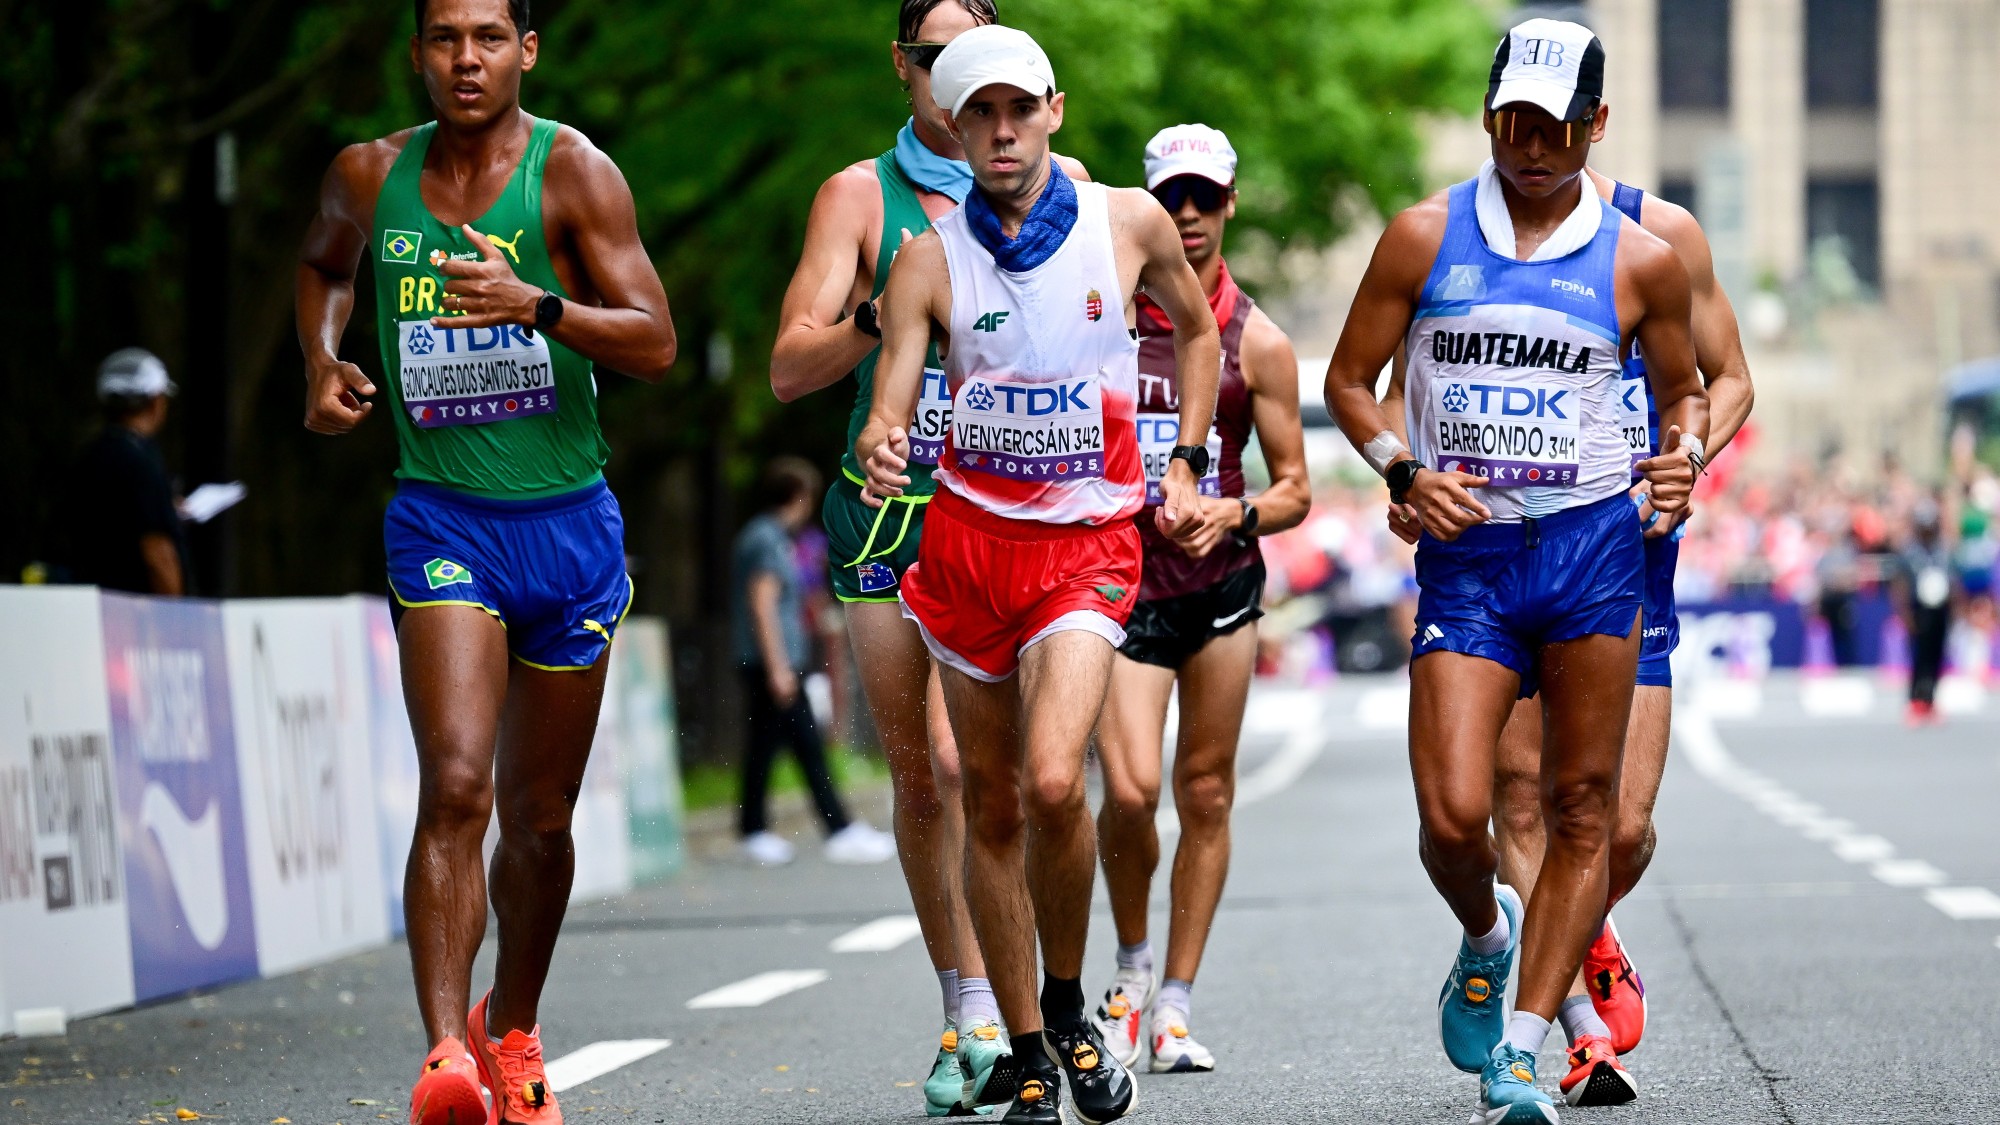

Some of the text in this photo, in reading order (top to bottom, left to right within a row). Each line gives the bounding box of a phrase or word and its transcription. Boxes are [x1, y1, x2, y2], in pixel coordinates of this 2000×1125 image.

[1550, 278, 1597, 299] FDNA
[433, 323, 536, 353] TDK
[1432, 329, 1592, 375] GUATEMALA
[477, 358, 520, 393] SANTOS
[520, 361, 548, 389] 307
[993, 380, 1091, 416] TDK
[1469, 383, 1569, 421] TDK
[957, 421, 1101, 456] VENYERCSÁN 342
[1439, 420, 1576, 460] BARRONDO 341
